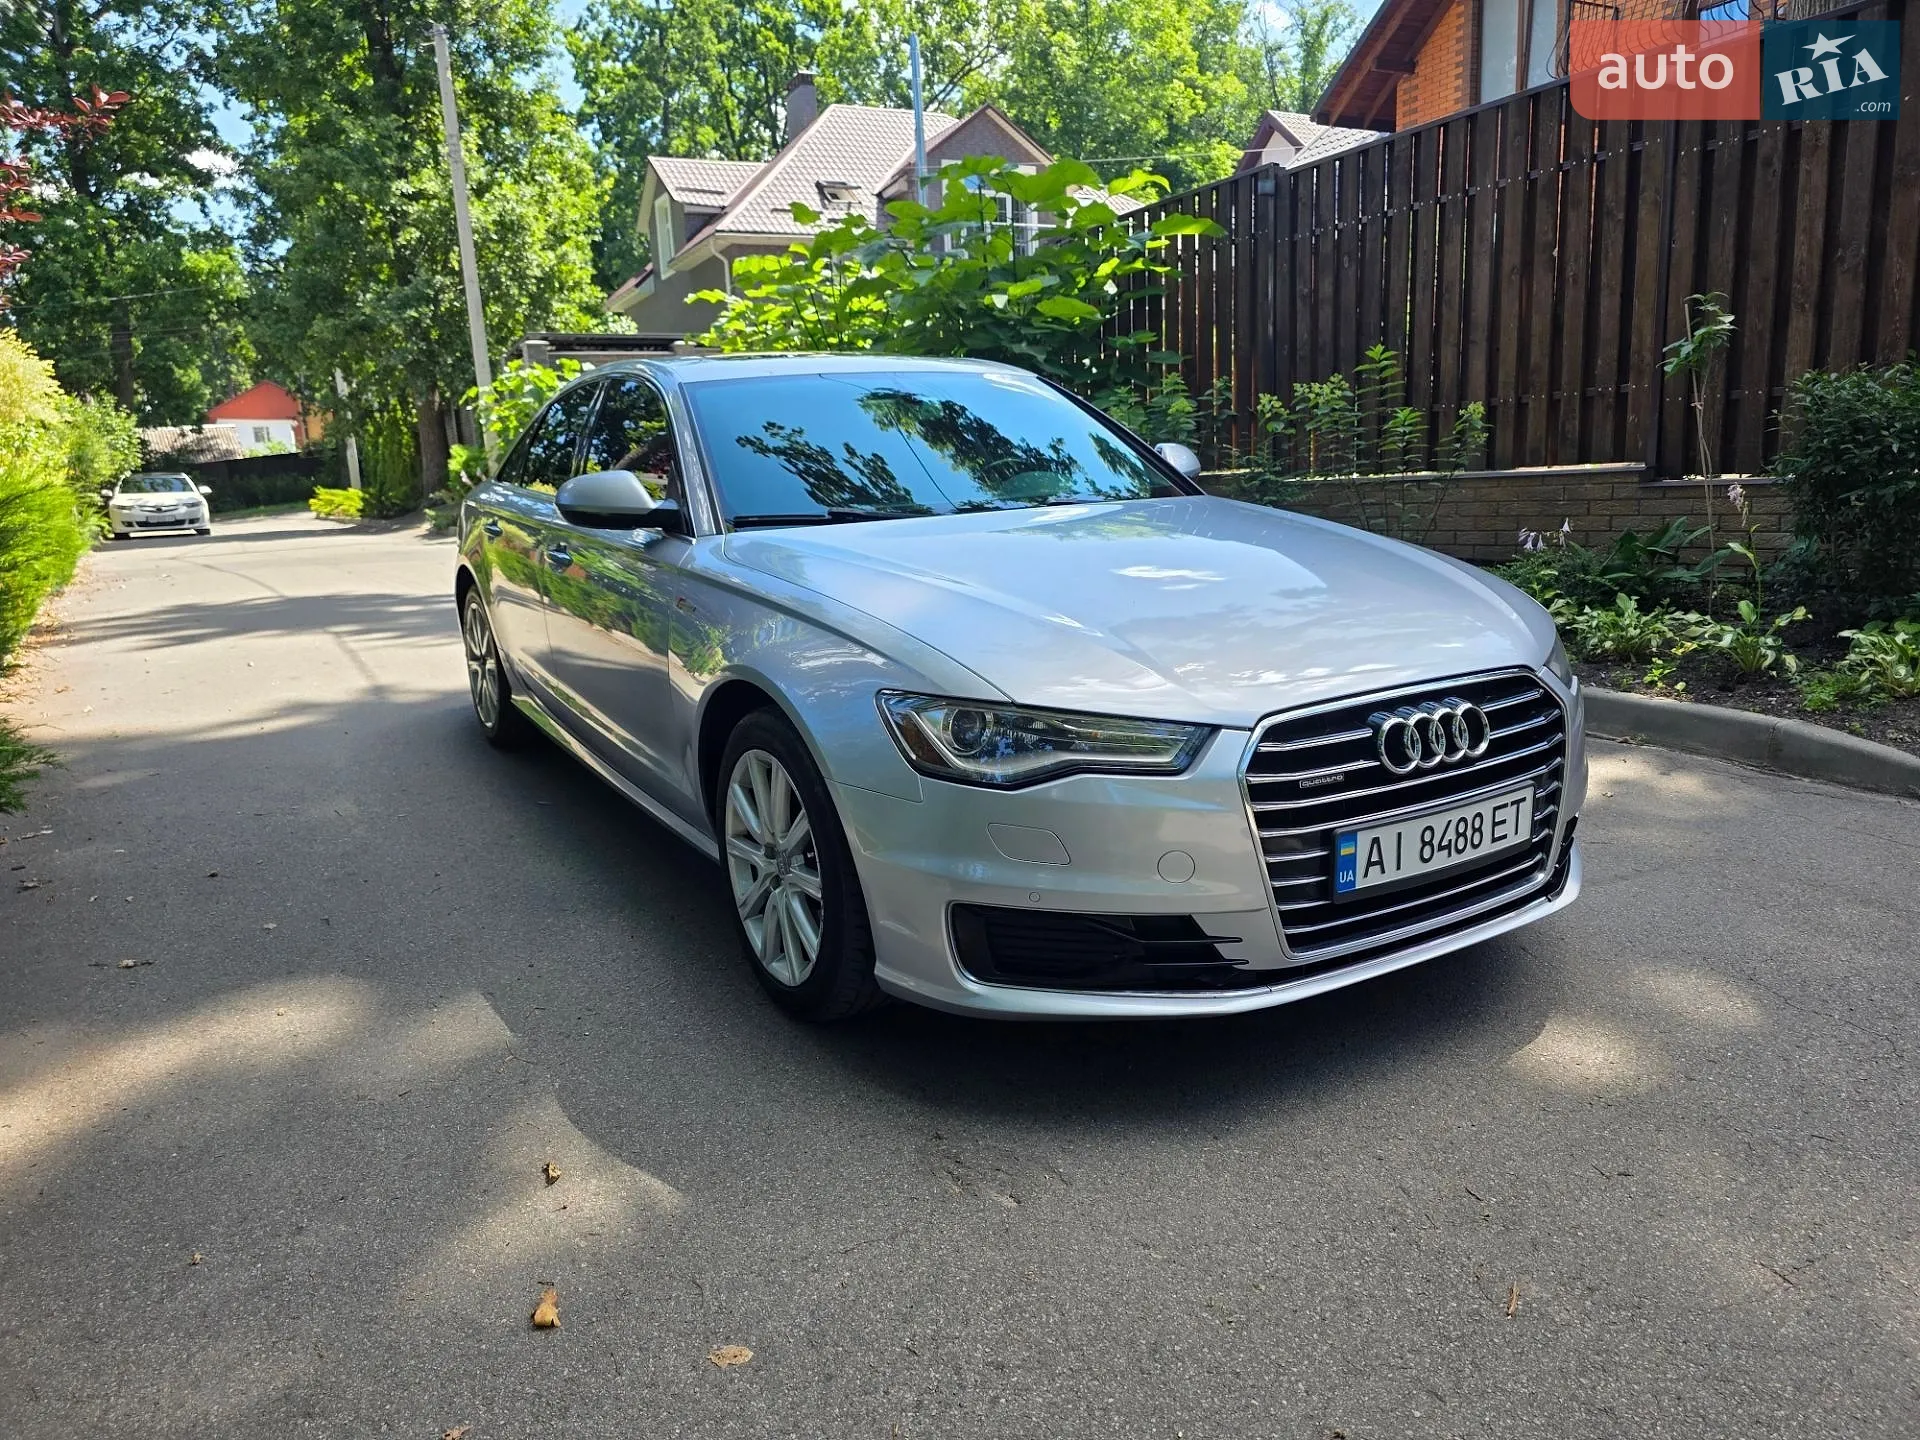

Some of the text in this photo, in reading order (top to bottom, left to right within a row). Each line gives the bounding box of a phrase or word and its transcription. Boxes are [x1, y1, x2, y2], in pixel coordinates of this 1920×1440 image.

[1301, 774, 1343, 788] quattro
[1363, 796, 1527, 878] AI 8488 ET
[1339, 870, 1354, 883] UA
